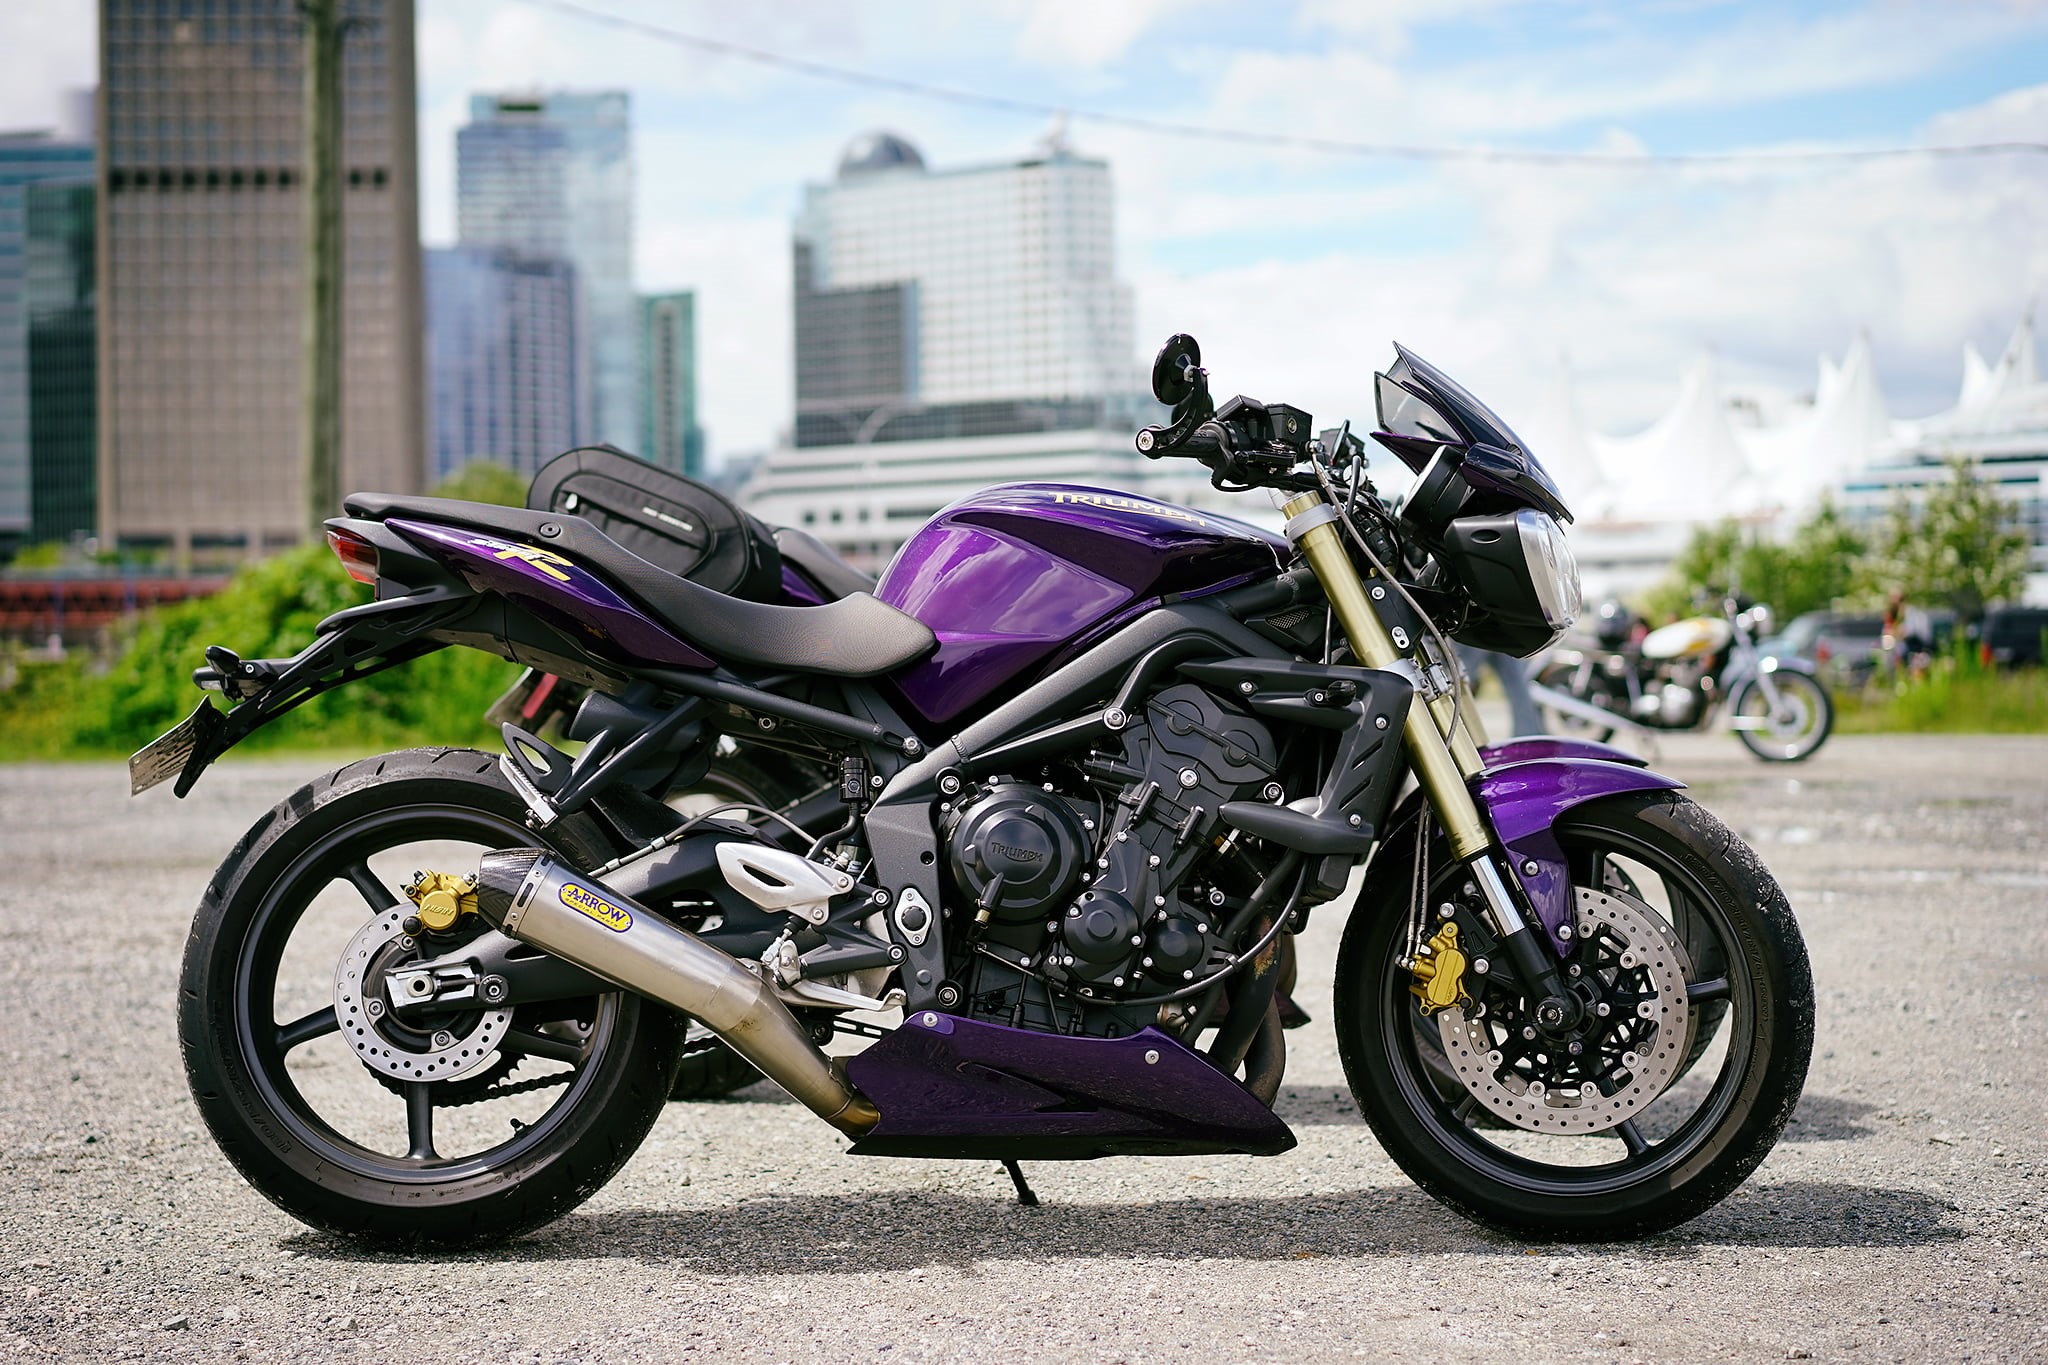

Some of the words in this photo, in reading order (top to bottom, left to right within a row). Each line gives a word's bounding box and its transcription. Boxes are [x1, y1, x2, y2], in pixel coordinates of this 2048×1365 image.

[1048, 492, 1206, 527] TRIUMPH
[991, 842, 1044, 862] TRIUMPH
[567, 888, 626, 922] ARROW
